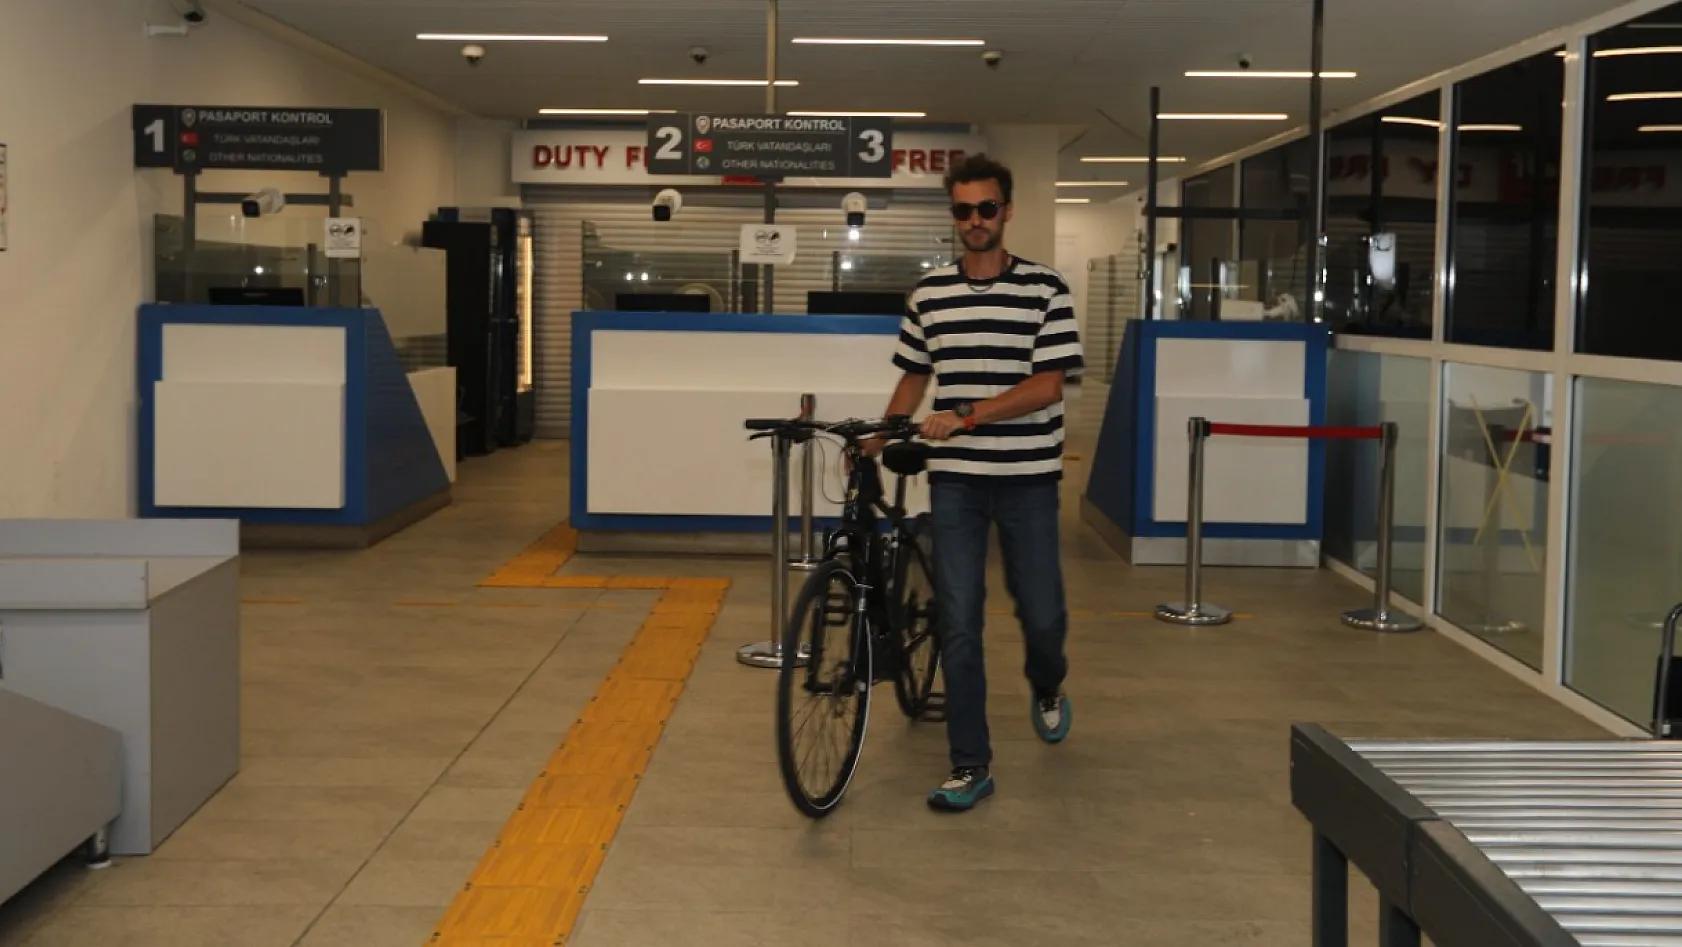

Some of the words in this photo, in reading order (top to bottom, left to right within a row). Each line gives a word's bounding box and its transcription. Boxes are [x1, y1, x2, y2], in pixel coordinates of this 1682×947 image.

[199, 110, 268, 123] PASAPORT
[270, 111, 334, 125] KONTROL
[712, 118, 781, 130] PASAPORT
[784, 119, 847, 131] KONTROL
[143, 118, 165, 153] 1
[654, 126, 683, 160] 2
[727, 139, 756, 151] TÜRK
[757, 141, 832, 153] VATANDAŞLARI
[857, 129, 885, 163] 3
[209, 151, 243, 163] OTHER
[246, 152, 324, 164] NATIONALITIES
[533, 144, 610, 169] DUTY
[721, 159, 760, 170] OTHER
[762, 160, 835, 171] NATIONALITIES
